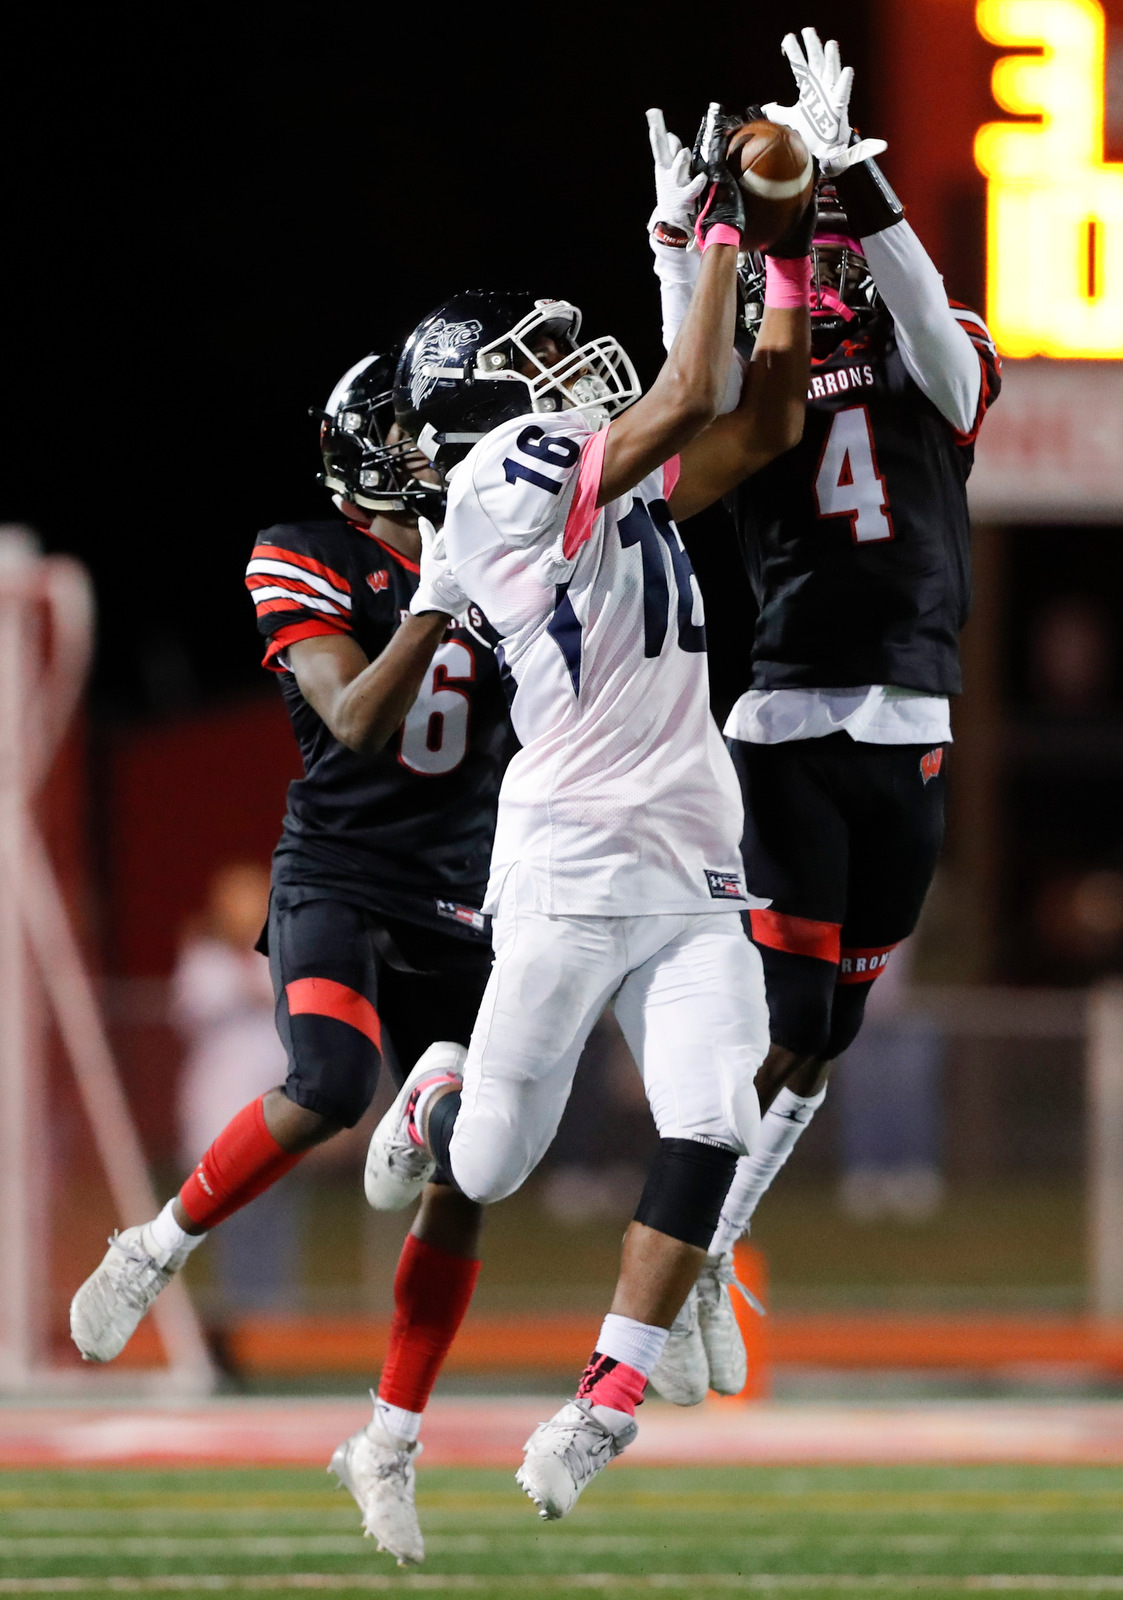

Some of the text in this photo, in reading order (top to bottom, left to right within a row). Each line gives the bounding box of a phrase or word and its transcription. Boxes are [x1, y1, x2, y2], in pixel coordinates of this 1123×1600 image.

[502, 425, 580, 496] 16
[812, 403, 895, 544] 4
[397, 637, 476, 777] 6
